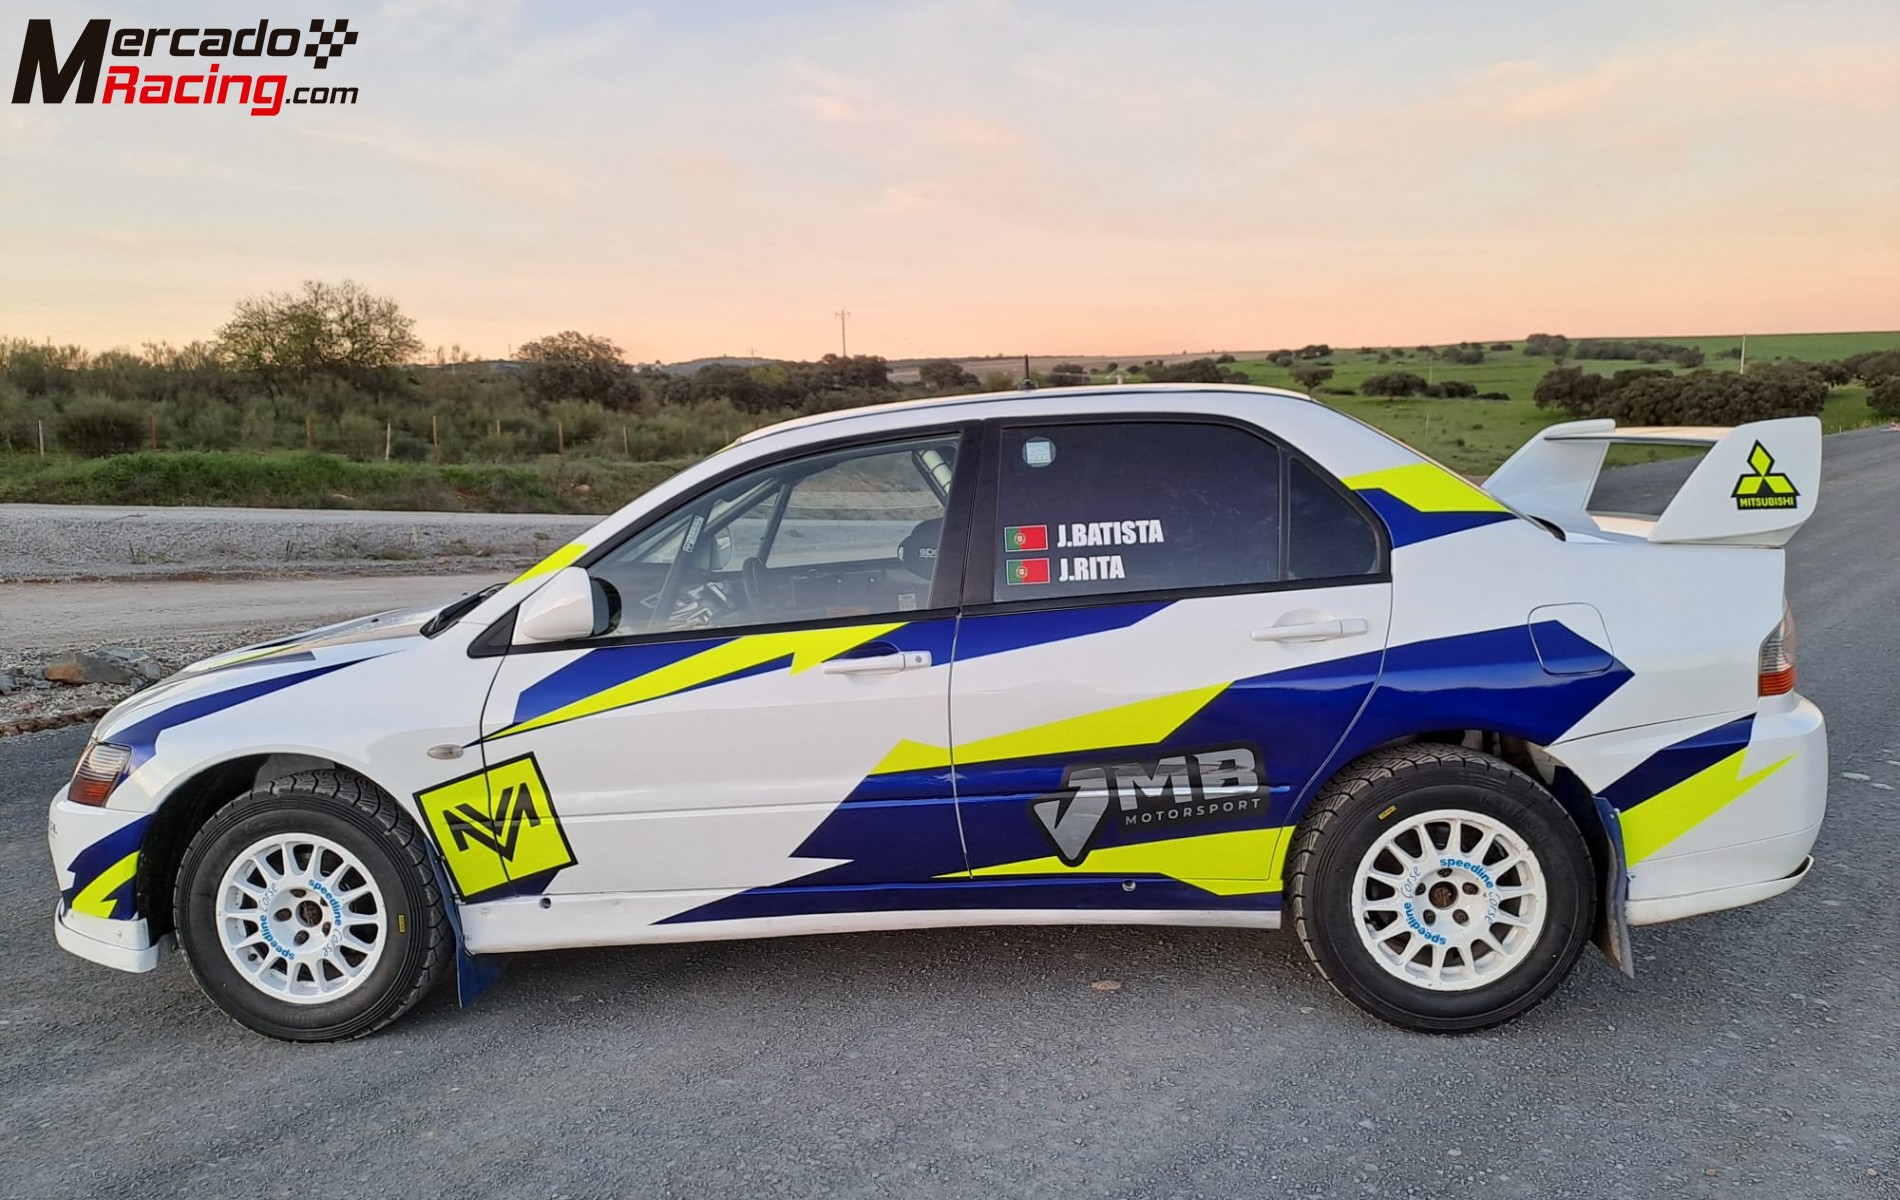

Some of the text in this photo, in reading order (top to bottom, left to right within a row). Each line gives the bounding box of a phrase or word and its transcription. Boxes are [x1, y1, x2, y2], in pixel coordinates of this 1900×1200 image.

[1740, 496, 1794, 507] MITSUBISHI
[1057, 519, 1165, 548] J.BATISTA
[1059, 555, 1126, 582] J.RITA
[1033, 748, 1259, 861] JMB
[1125, 798, 1261, 826] MOTORSPORT
[1439, 857, 1494, 889] speedline
[308, 878, 342, 926] speedline
[260, 914, 295, 960] speedline
[1403, 901, 1447, 946] speedline
